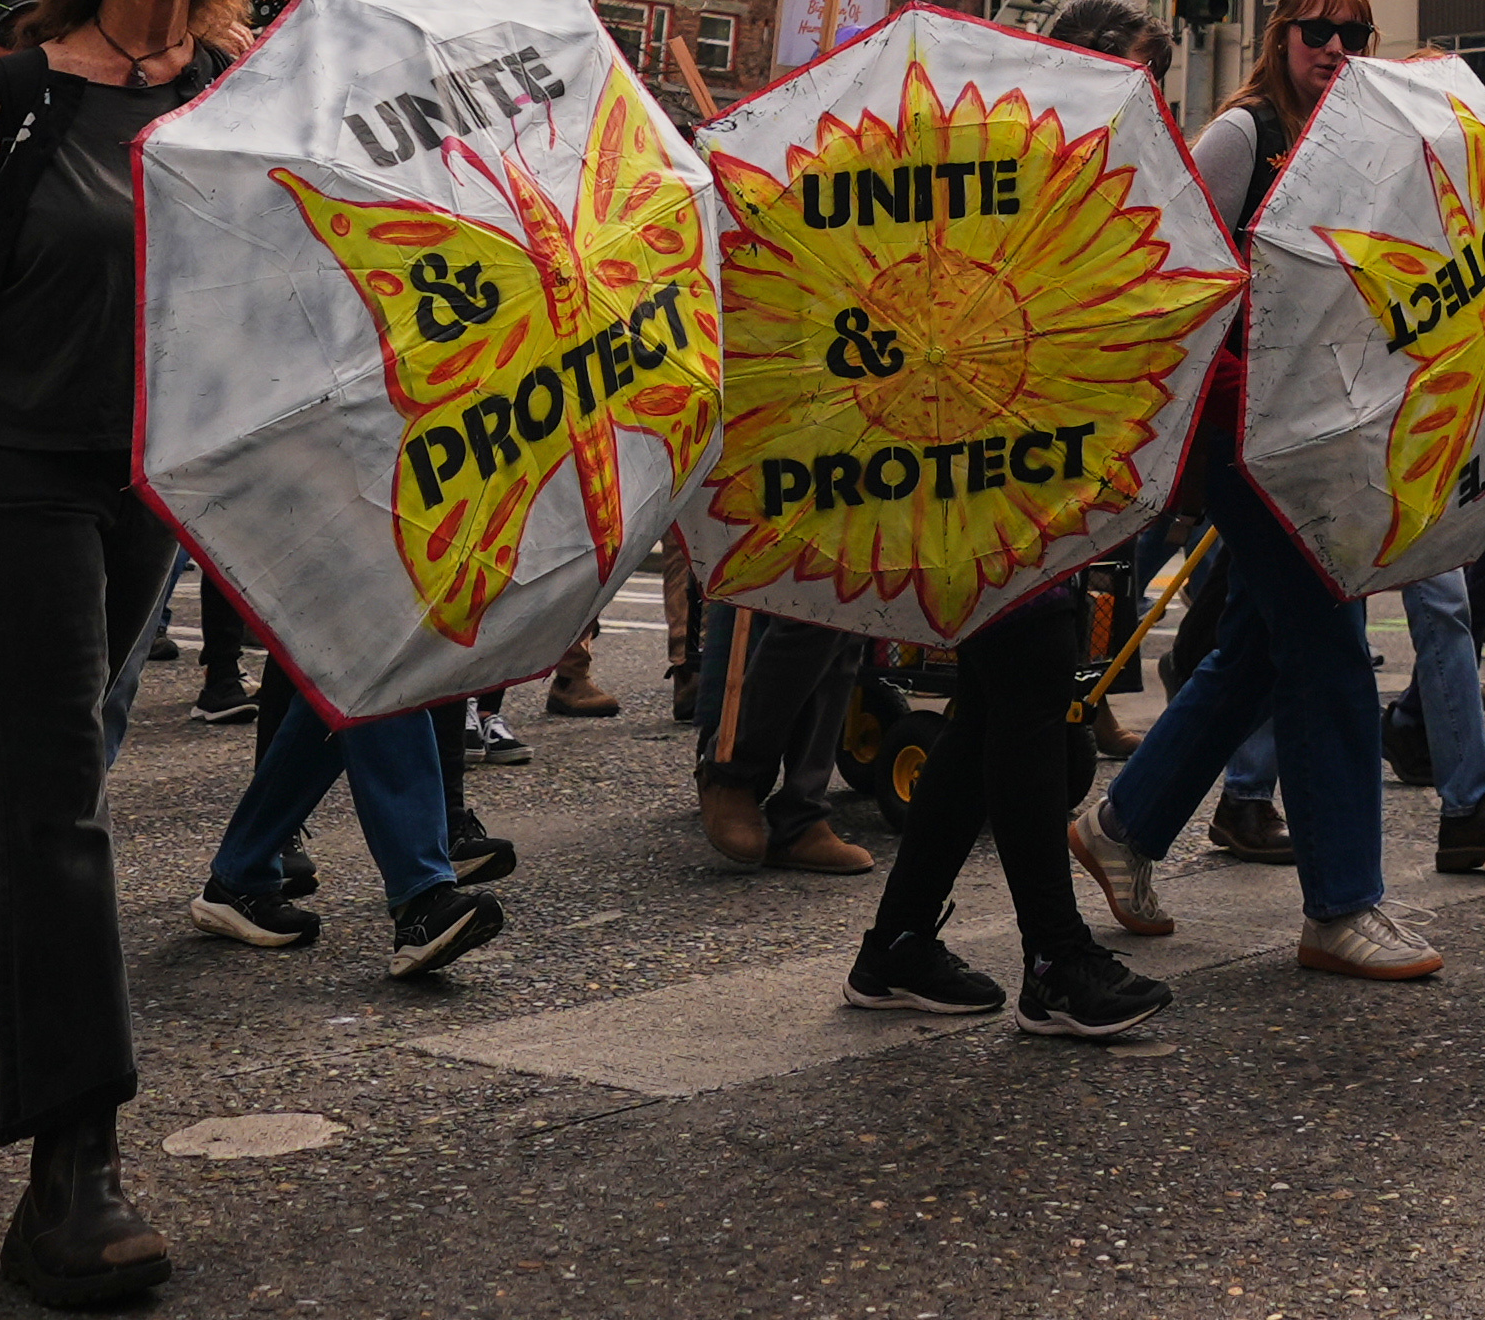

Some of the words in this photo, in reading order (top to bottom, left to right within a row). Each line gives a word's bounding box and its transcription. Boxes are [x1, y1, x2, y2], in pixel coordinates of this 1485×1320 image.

[343, 46, 566, 168] UNITE
[801, 158, 1020, 232] UNITE
[409, 252, 500, 343] &
[826, 306, 904, 379] &
[405, 281, 689, 510] PROTECT
[762, 422, 1095, 518] PROTECT
